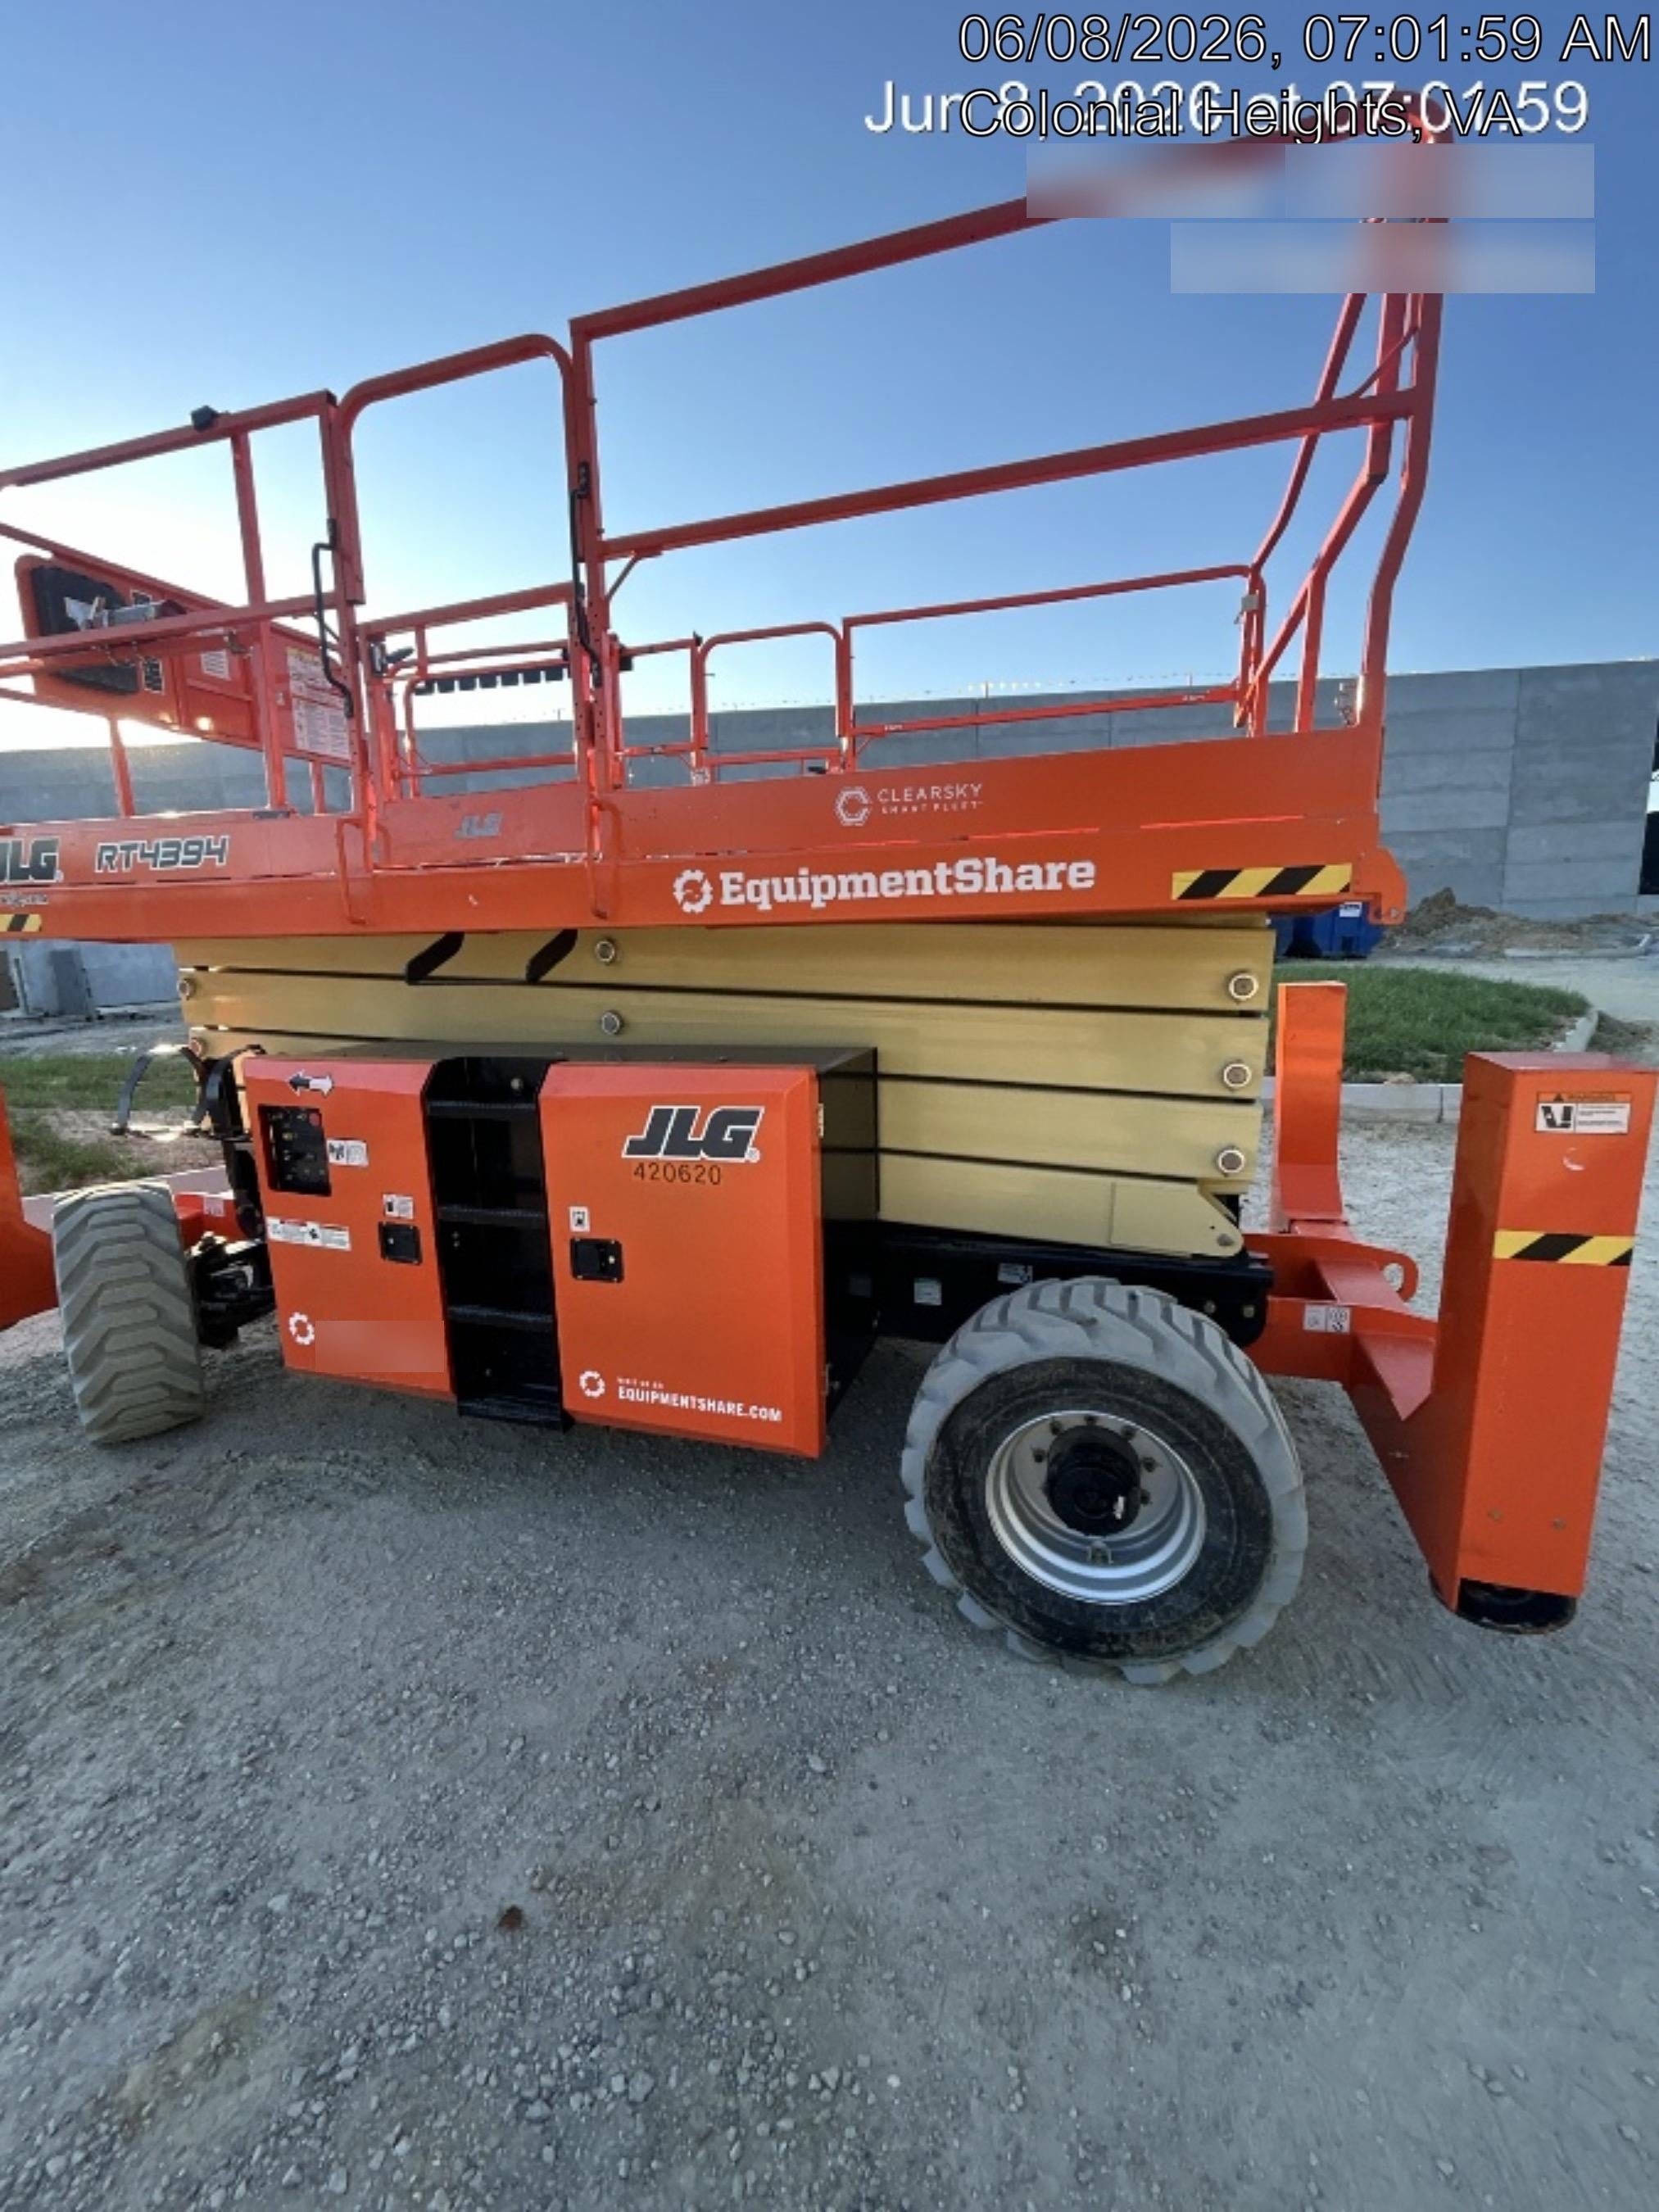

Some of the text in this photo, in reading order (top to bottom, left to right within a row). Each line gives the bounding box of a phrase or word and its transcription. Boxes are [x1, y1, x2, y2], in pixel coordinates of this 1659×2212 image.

[877, 783, 982, 803] CLEARSKY
[95, 835, 230, 873] RT4394
[719, 857, 1096, 911] EquipmentShare
[621, 1105, 765, 1163] JLG
[633, 1162, 722, 1185] 420620
[618, 1385, 783, 1422] EQUIPMENTSHARE.COM
